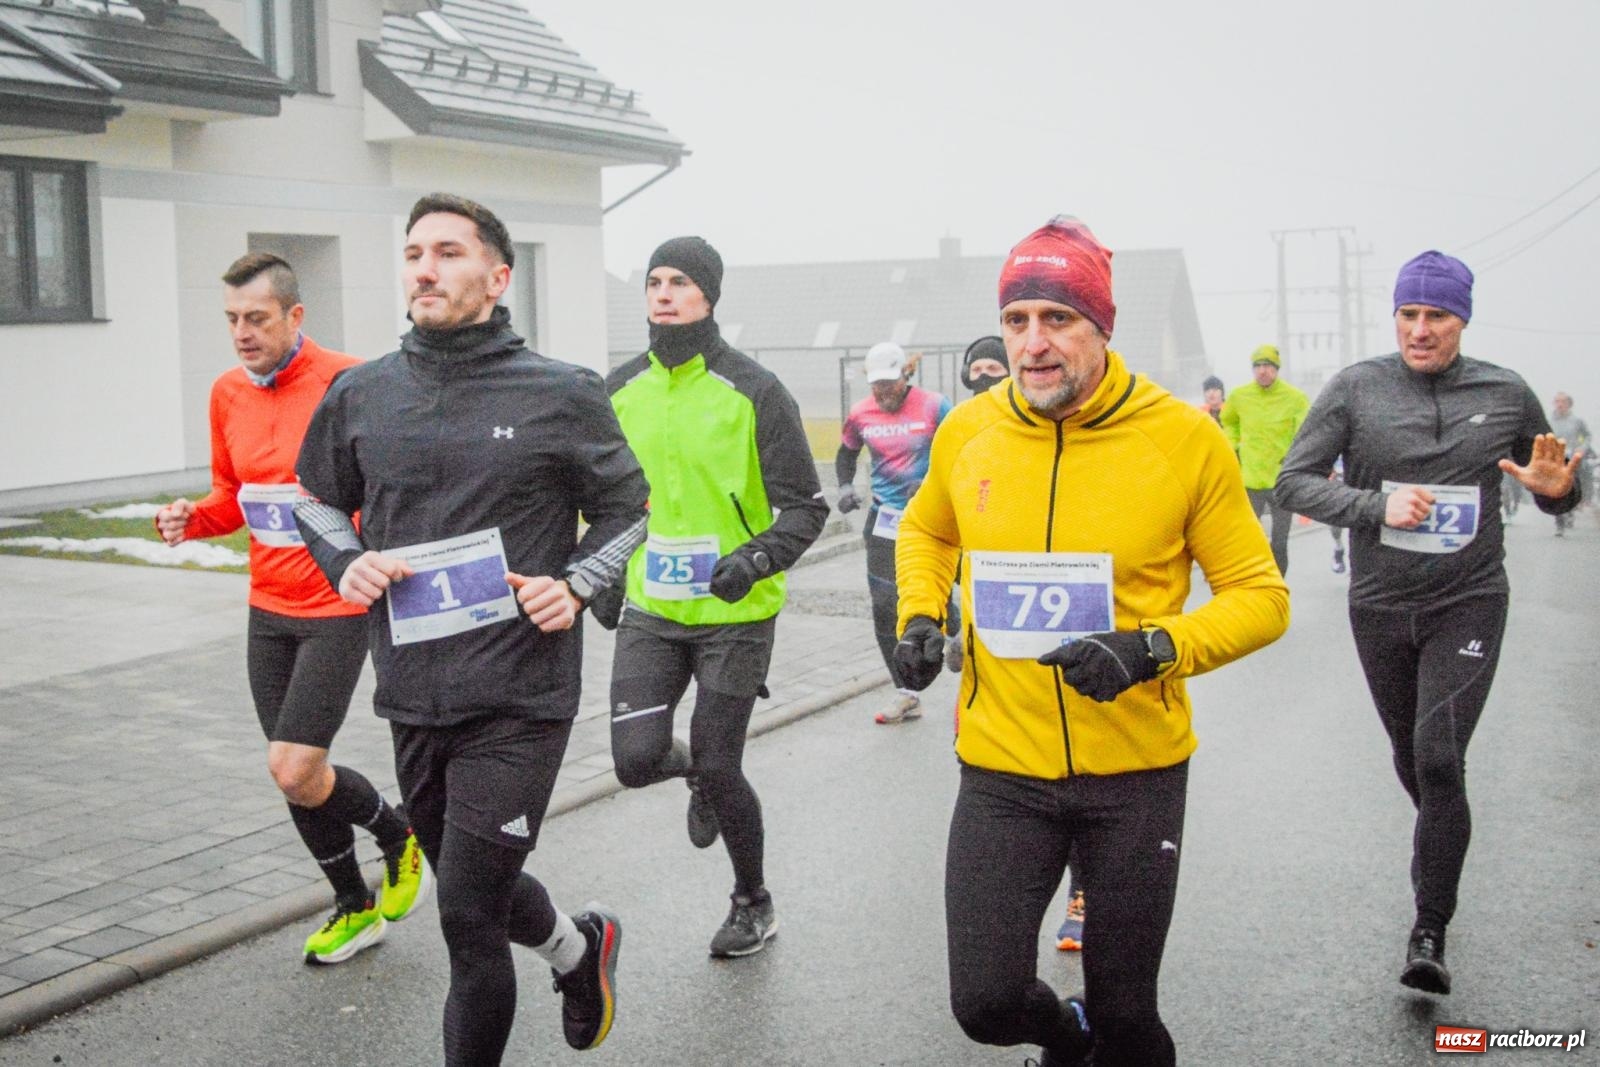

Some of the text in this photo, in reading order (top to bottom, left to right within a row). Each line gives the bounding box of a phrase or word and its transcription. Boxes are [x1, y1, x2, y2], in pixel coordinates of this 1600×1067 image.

[267, 504, 282, 529] 3
[659, 556, 694, 582] 25
[431, 570, 461, 610] 1
[1008, 585, 1070, 628] 79
